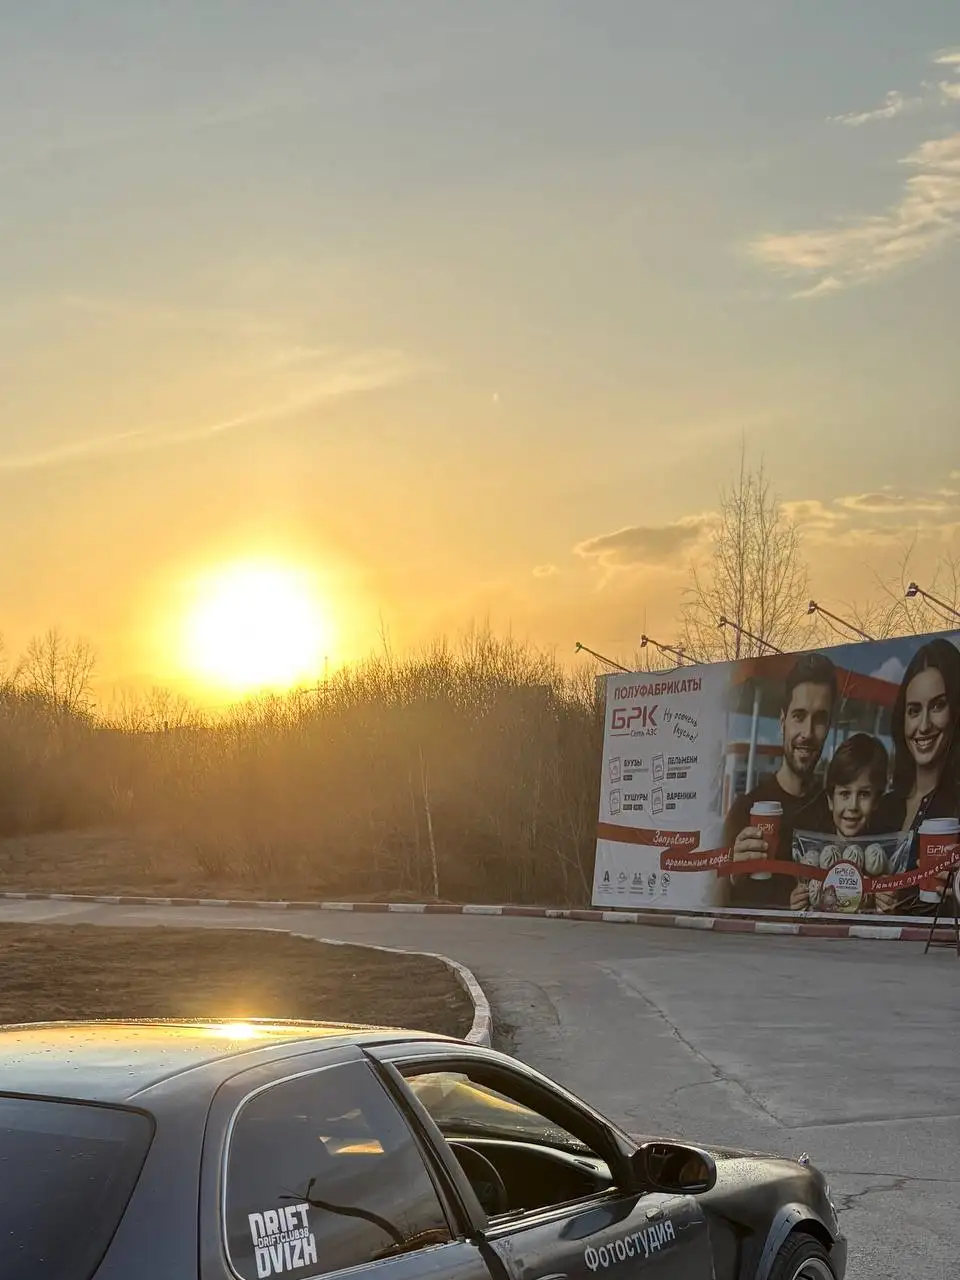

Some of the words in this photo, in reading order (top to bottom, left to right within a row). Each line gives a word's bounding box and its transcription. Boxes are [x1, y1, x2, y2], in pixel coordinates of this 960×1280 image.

[614, 678, 702, 700] ПОЛУФАБРИКАТЫ
[611, 705, 659, 730] БРК
[667, 755, 698, 765] ПЕЛЬМЕНИ
[666, 791, 697, 801] ВАРЕНИКИ
[248, 1203, 309, 1246] DRIFT
[258, 1228, 309, 1248] DRIFTCLUB38
[584, 1220, 675, 1271] Фотостудия
[255, 1233, 318, 1279] DVIZH
